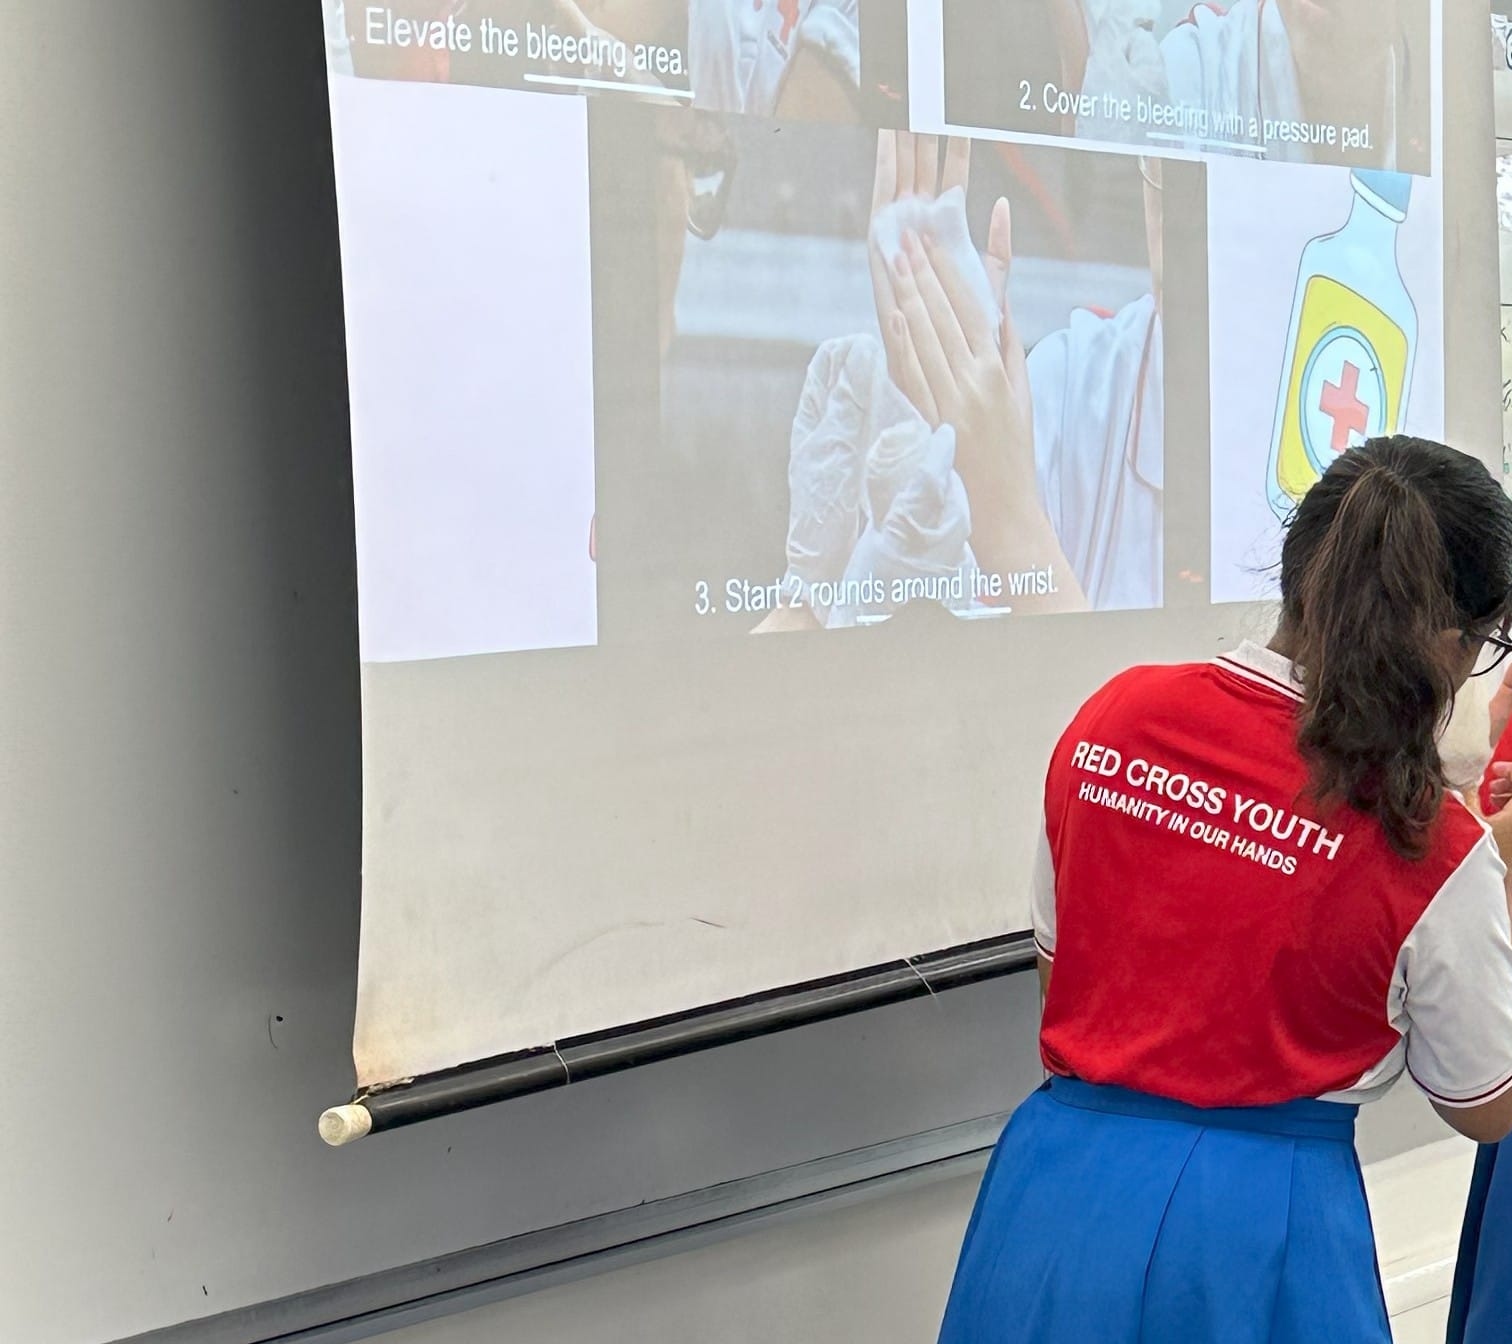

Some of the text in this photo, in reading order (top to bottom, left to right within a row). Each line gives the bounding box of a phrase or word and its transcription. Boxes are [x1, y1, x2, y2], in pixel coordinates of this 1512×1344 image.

[365, 6, 688, 78] Elevate the bleeding area.
[1018, 79, 1374, 153] 2. Cover the bleeding with a pressure pad.
[694, 564, 1059, 616] 3. Start 2 rounds around the wrist.
[1071, 741, 1344, 861] RED CROSS YOUTH
[1079, 782, 1297, 876] HUMANITY IN OUR HANDS
